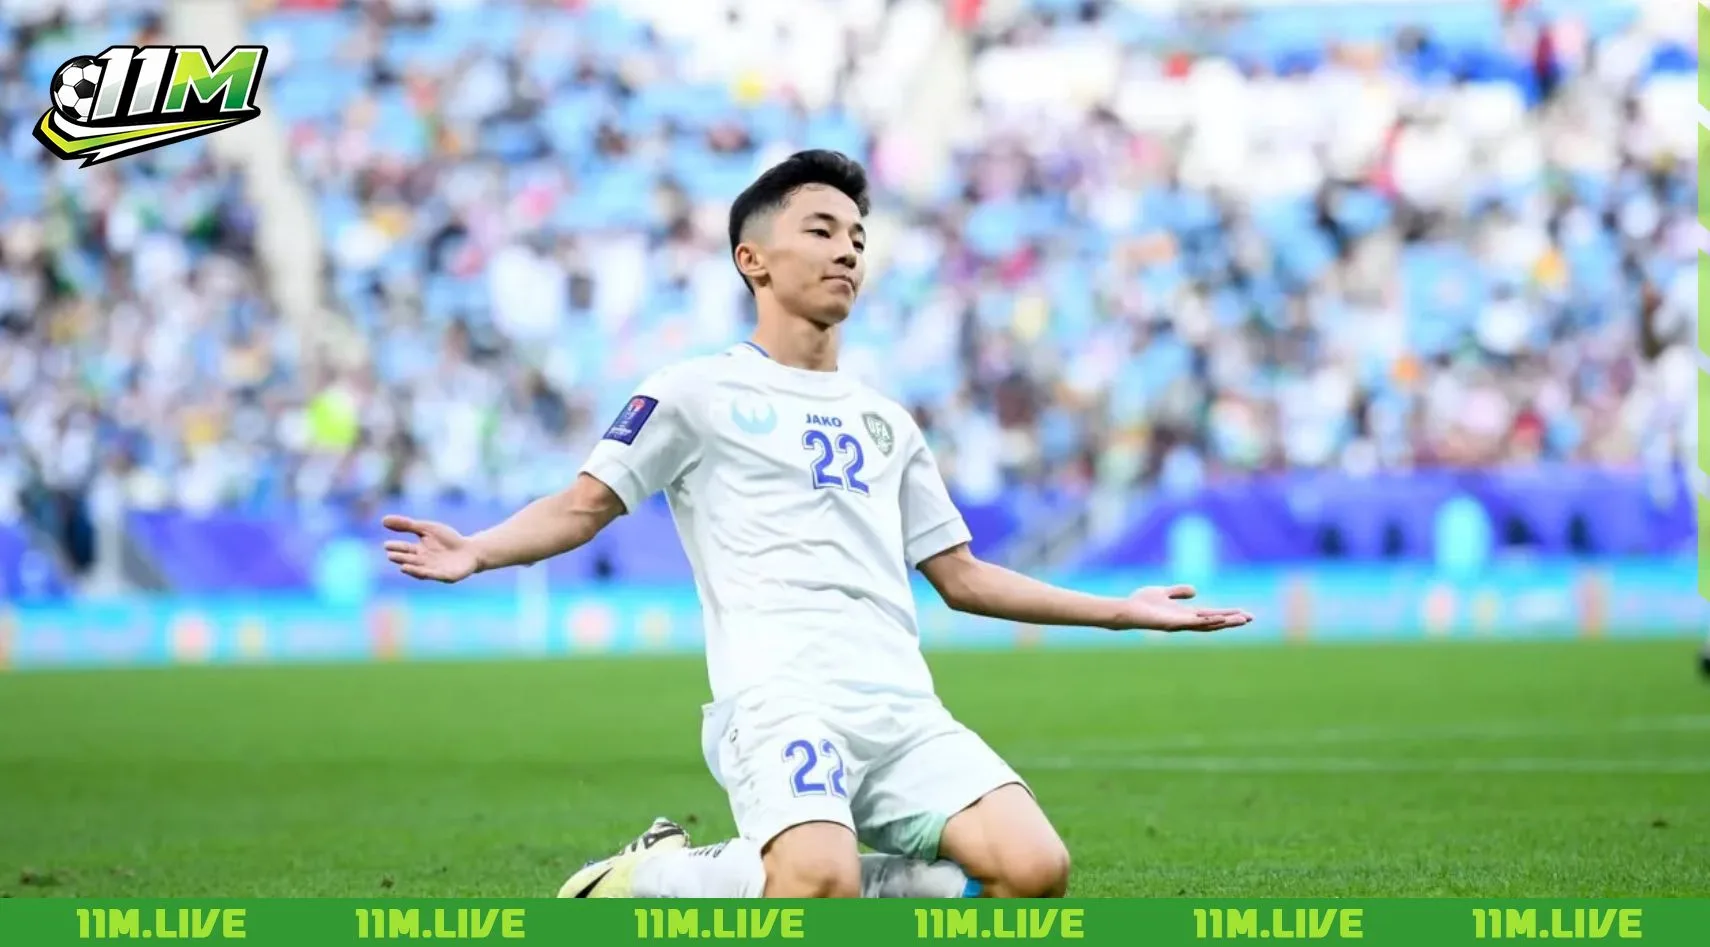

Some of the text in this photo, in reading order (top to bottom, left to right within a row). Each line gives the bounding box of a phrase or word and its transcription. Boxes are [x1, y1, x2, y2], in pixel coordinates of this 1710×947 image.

[805, 413, 843, 428] JAKO
[802, 430, 870, 497] 22
[782, 739, 847, 798] 22
